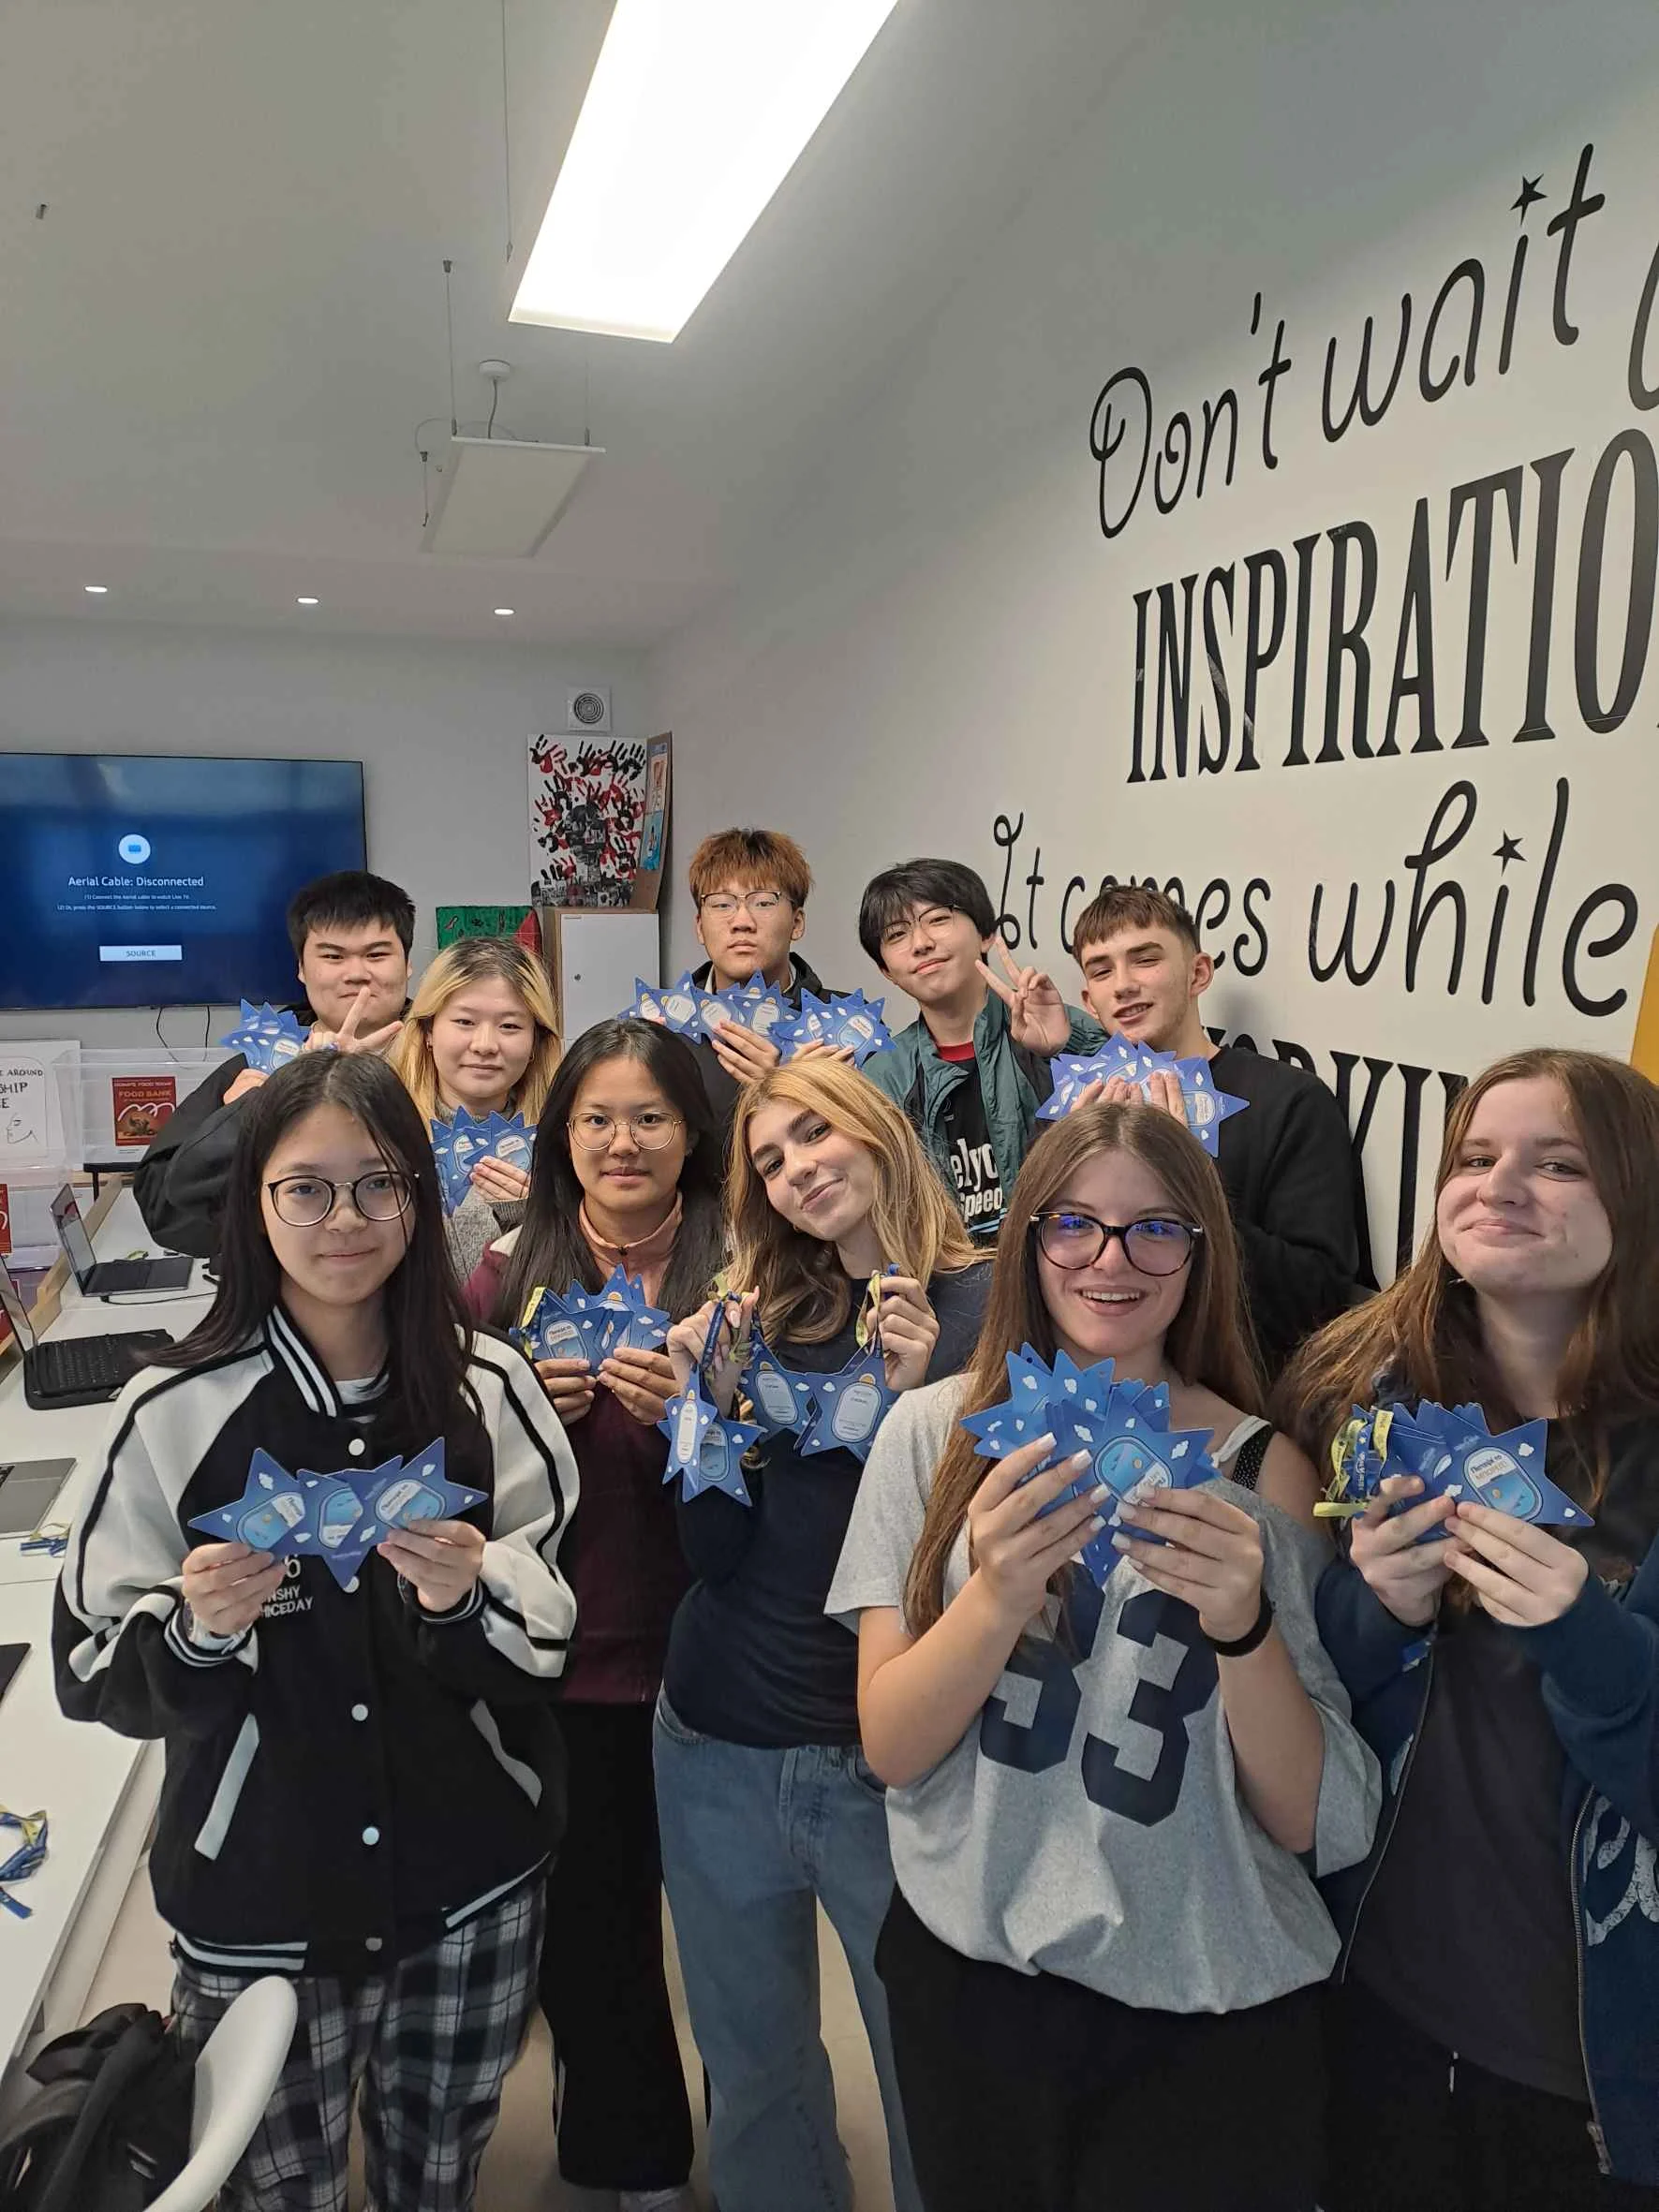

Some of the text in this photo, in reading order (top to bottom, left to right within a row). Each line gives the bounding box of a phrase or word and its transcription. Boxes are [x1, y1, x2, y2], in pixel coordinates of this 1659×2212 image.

[1089, 292, 1292, 538] Don't
[1322, 143, 1606, 443] wait
[1127, 428, 1659, 783] INSPIRATIO
[68, 877, 204, 886] Aerial Cable: Disconnected
[993, 776, 1638, 1017] It ces while
